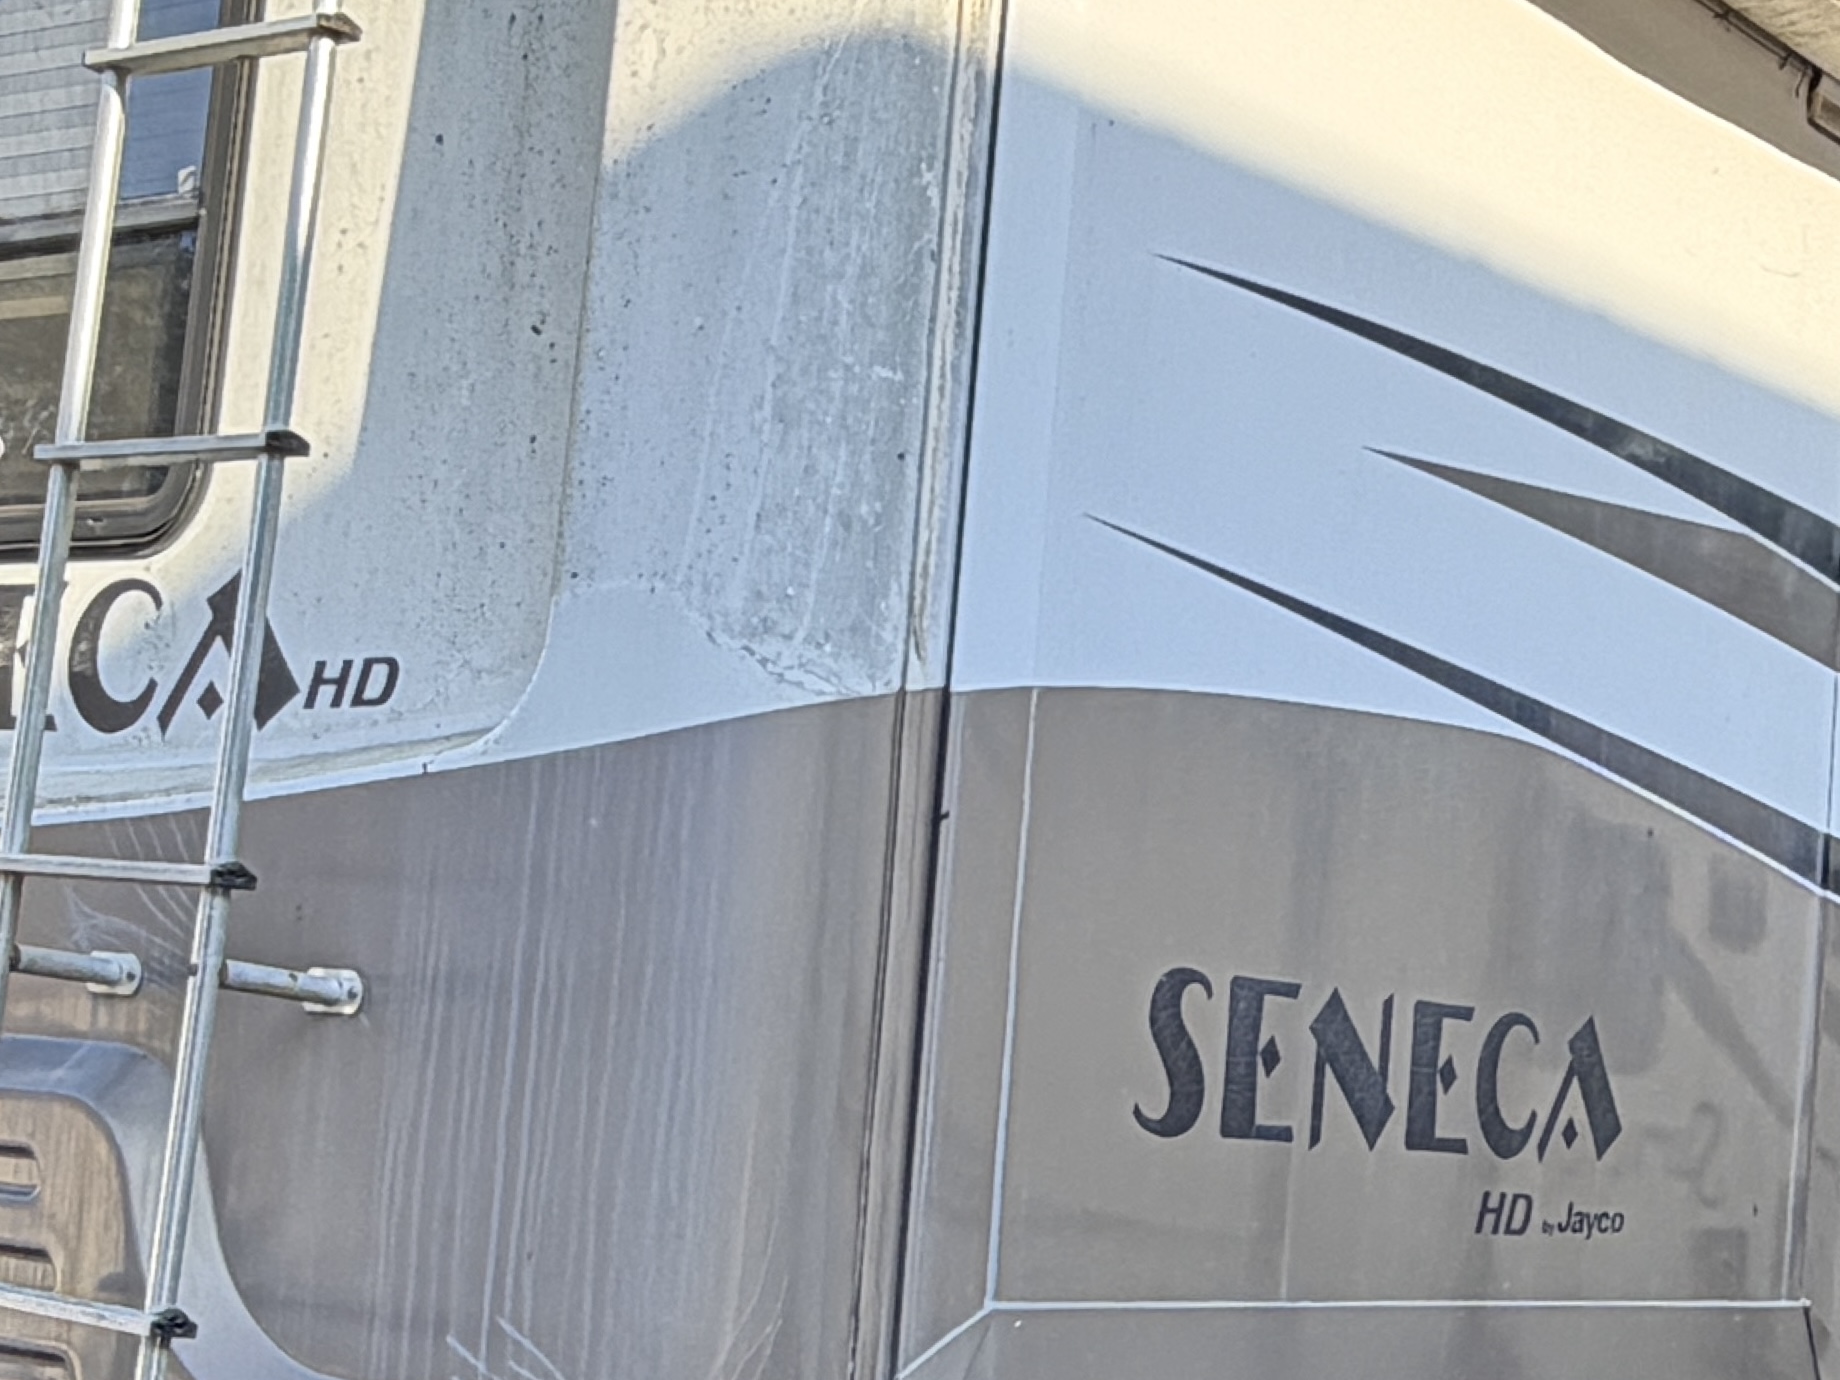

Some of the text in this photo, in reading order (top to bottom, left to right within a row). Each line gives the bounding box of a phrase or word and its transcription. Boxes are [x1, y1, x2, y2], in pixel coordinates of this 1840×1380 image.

[303, 656, 401, 711] HD
[1132, 966, 1623, 1163] SENECA
[1474, 1189, 1534, 1237] HD
[1557, 1200, 1625, 1241] Jayco
